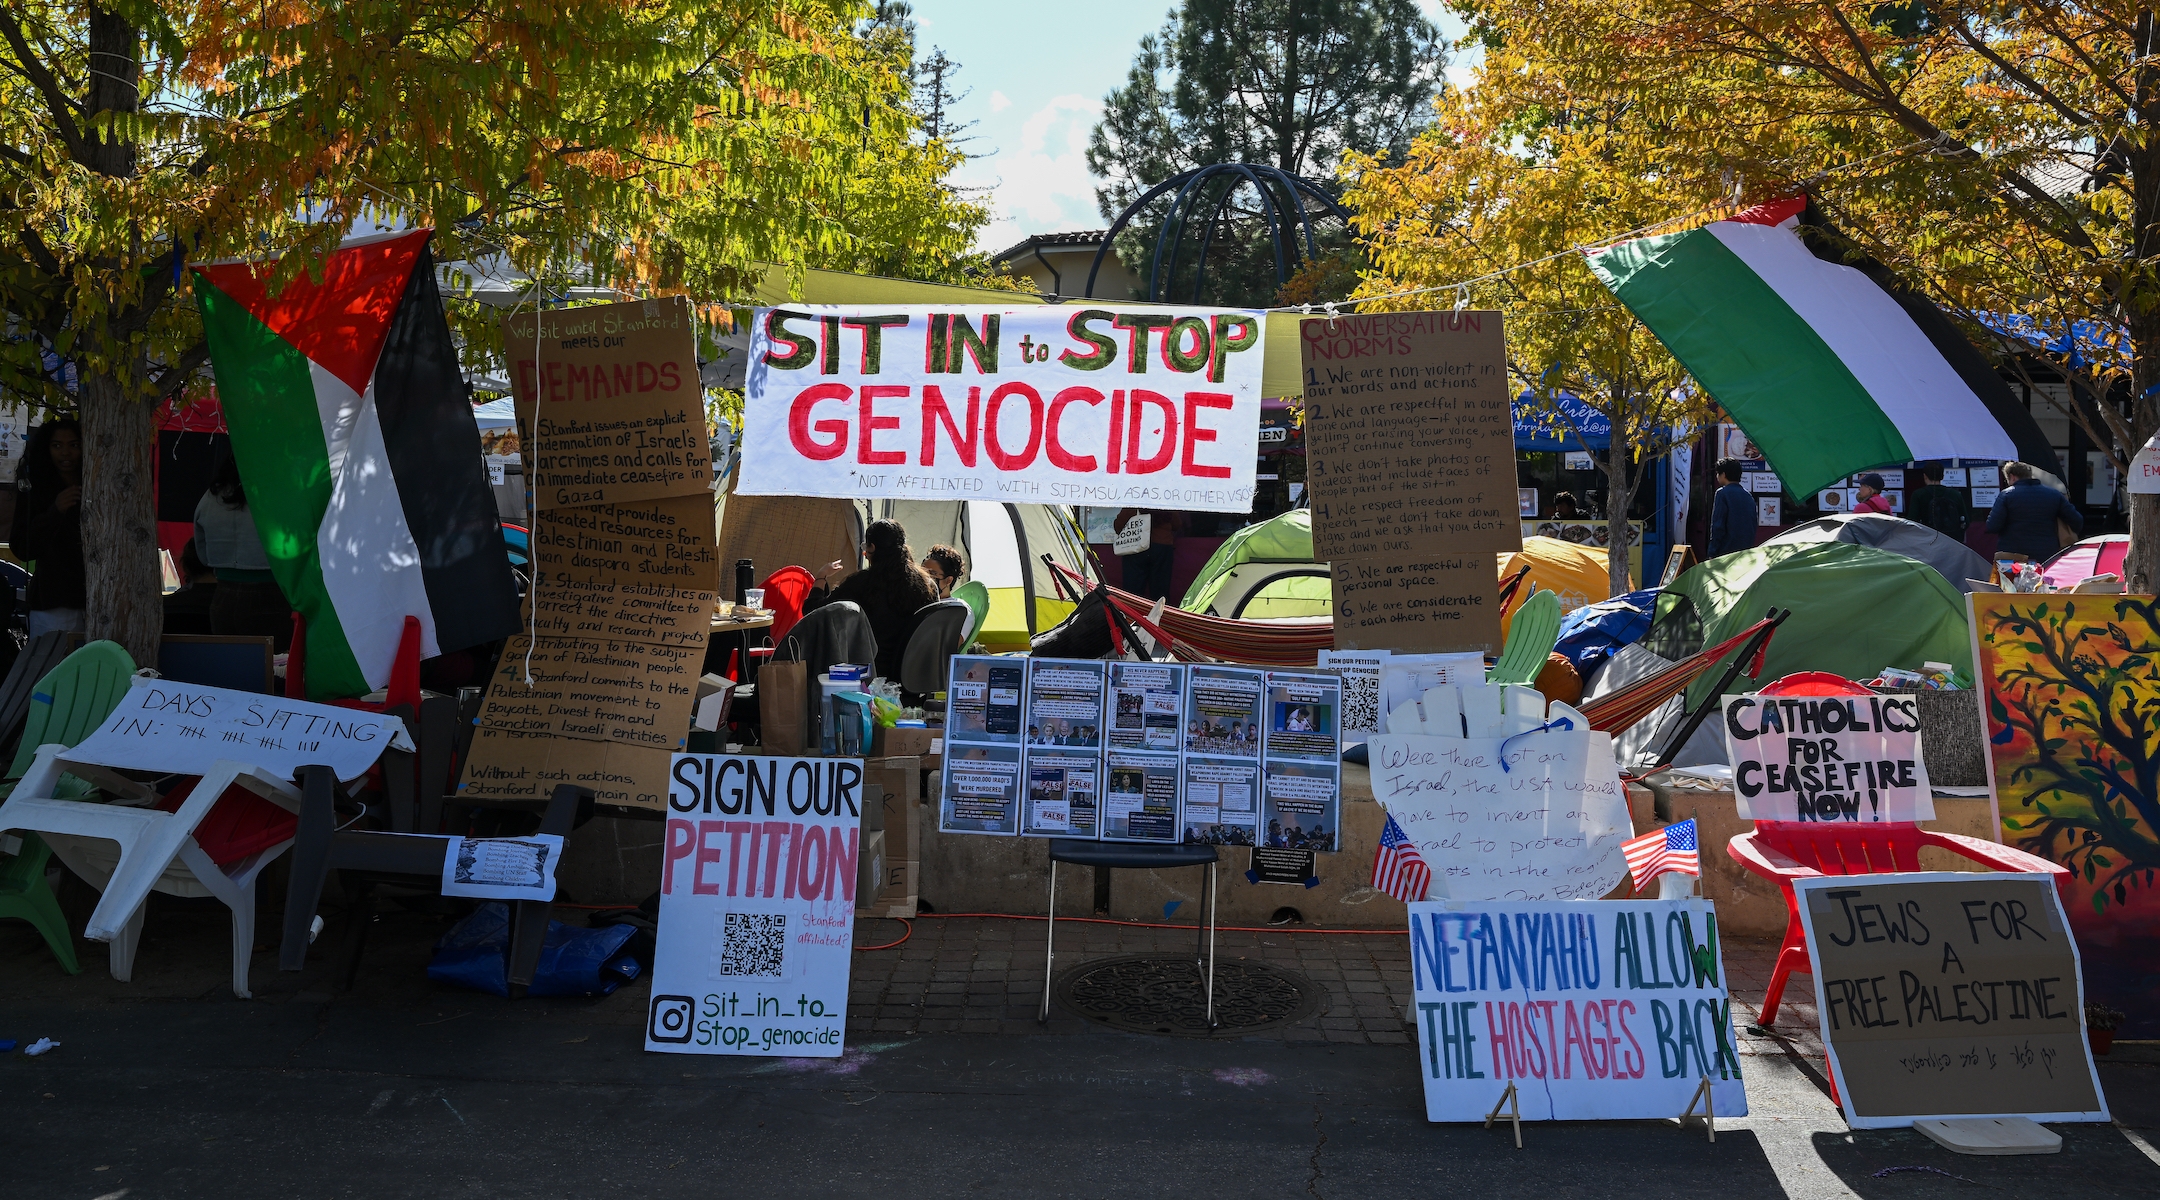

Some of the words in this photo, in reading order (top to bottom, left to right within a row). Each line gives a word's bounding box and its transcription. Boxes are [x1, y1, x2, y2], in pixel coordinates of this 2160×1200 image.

[510, 321, 535, 339] We
[540, 323, 560, 339] sit
[565, 319, 597, 336] until
[603, 312, 679, 335] Stanford
[1301, 313, 1482, 342] CONVERSATION
[561, 336, 600, 350] meets
[603, 335, 627, 349] our
[762, 308, 910, 375] SIT
[926, 313, 1000, 374] IN
[1019, 334, 1048, 364] to
[1058, 310, 1259, 383] STOP
[1311, 336, 1412, 361] NORMS
[517, 359, 682, 403] DEMANDS
[1306, 367, 1325, 387] 1.
[1326, 365, 1353, 384] We
[1360, 367, 1383, 379] are
[1390, 361, 1476, 378] non-violent
[1480, 363, 1496, 376] in
[1308, 386, 1333, 398] our
[1341, 380, 1384, 395] words
[1390, 378, 1417, 390] and
[538, 418, 592, 437] Stanford
[595, 420, 628, 432] issues
[629, 420, 643, 429] an
[646, 409, 686, 434] explicit
[788, 381, 1235, 479] GENOCIDE
[521, 434, 612, 452] condemnation
[615, 431, 631, 446] of
[635, 428, 696, 450] Israel's
[613, 449, 643, 468] and
[645, 451, 682, 467] calls
[685, 453, 707, 469] for
[525, 472, 545, 487] an
[548, 469, 617, 486] immediate
[620, 468, 685, 487] ceasefire
[691, 469, 703, 480] in
[897, 475, 984, 492] AFFILIATED
[997, 479, 1040, 495] WITH
[1163, 489, 1180, 500] OR
[1184, 489, 1225, 504] OTHER
[556, 488, 604, 505] Gaza
[1337, 562, 1353, 582] 5.
[1357, 565, 1381, 579] We
[1386, 564, 1403, 574] are
[1408, 559, 1462, 574] respectful
[1466, 560, 1480, 570] of
[1342, 578, 1393, 596] personal
[1398, 576, 1439, 590] space.
[1340, 599, 1355, 618] 6.
[1359, 600, 1378, 613] We
[1383, 601, 1403, 610] are
[1407, 594, 1482, 609] considerate
[1343, 617, 1356, 629] of
[1360, 614, 1387, 627] each
[1431, 610, 1464, 621] time.
[1351, 667, 1380, 675] GENOCIDE
[961, 689, 978, 697] LIED.
[142, 689, 216, 718] DAYS
[242, 704, 380, 742] SITTING
[1154, 701, 1175, 711] FALSE
[111, 716, 164, 737] IN:
[1726, 698, 1921, 741] CATHOLICS
[1441, 747, 1491, 769] there
[1497, 747, 1535, 765] not
[1538, 751, 1567, 764] an
[1788, 738, 1845, 765] FOR
[669, 757, 776, 816] SIGN
[787, 761, 862, 818] OUR
[1071, 780, 1092, 789] FALSE
[1385, 771, 1458, 797] Israel,
[1460, 778, 1500, 795] the
[1510, 776, 1554, 793] USA
[1563, 779, 1618, 797] would
[1736, 759, 1918, 798] CEASEFIRE
[1043, 812, 1065, 821] FALSE
[1390, 804, 1437, 824] have
[1446, 803, 1469, 824] to
[1486, 806, 1550, 822] invent
[1565, 811, 1590, 822] an
[1410, 833, 1462, 851] srael
[1470, 836, 1498, 853] to
[1511, 836, 1585, 858] protect
[662, 818, 858, 901] PETITION
[1482, 863, 1502, 877] in
[1509, 860, 1552, 878] the
[1552, 876, 1606, 900] Biden
[802, 913, 847, 928] Stanford
[1825, 890, 1930, 946] JEWS
[1961, 900, 2047, 944] FOR
[797, 932, 850, 948] affiliated?
[1412, 912, 1601, 992] NETANYAHU
[1615, 910, 1720, 989] ALLOW
[1941, 942, 1965, 975] A
[703, 992, 838, 1018] Sit_in_to_
[1824, 975, 1899, 1030] FREE
[1899, 970, 2067, 1028] PALESTINE
[696, 1020, 840, 1051] Stop_genocide
[1418, 1001, 1485, 1079] THE
[1485, 999, 1645, 1079] HOSTAGES
[1650, 998, 1743, 1080] BACK
